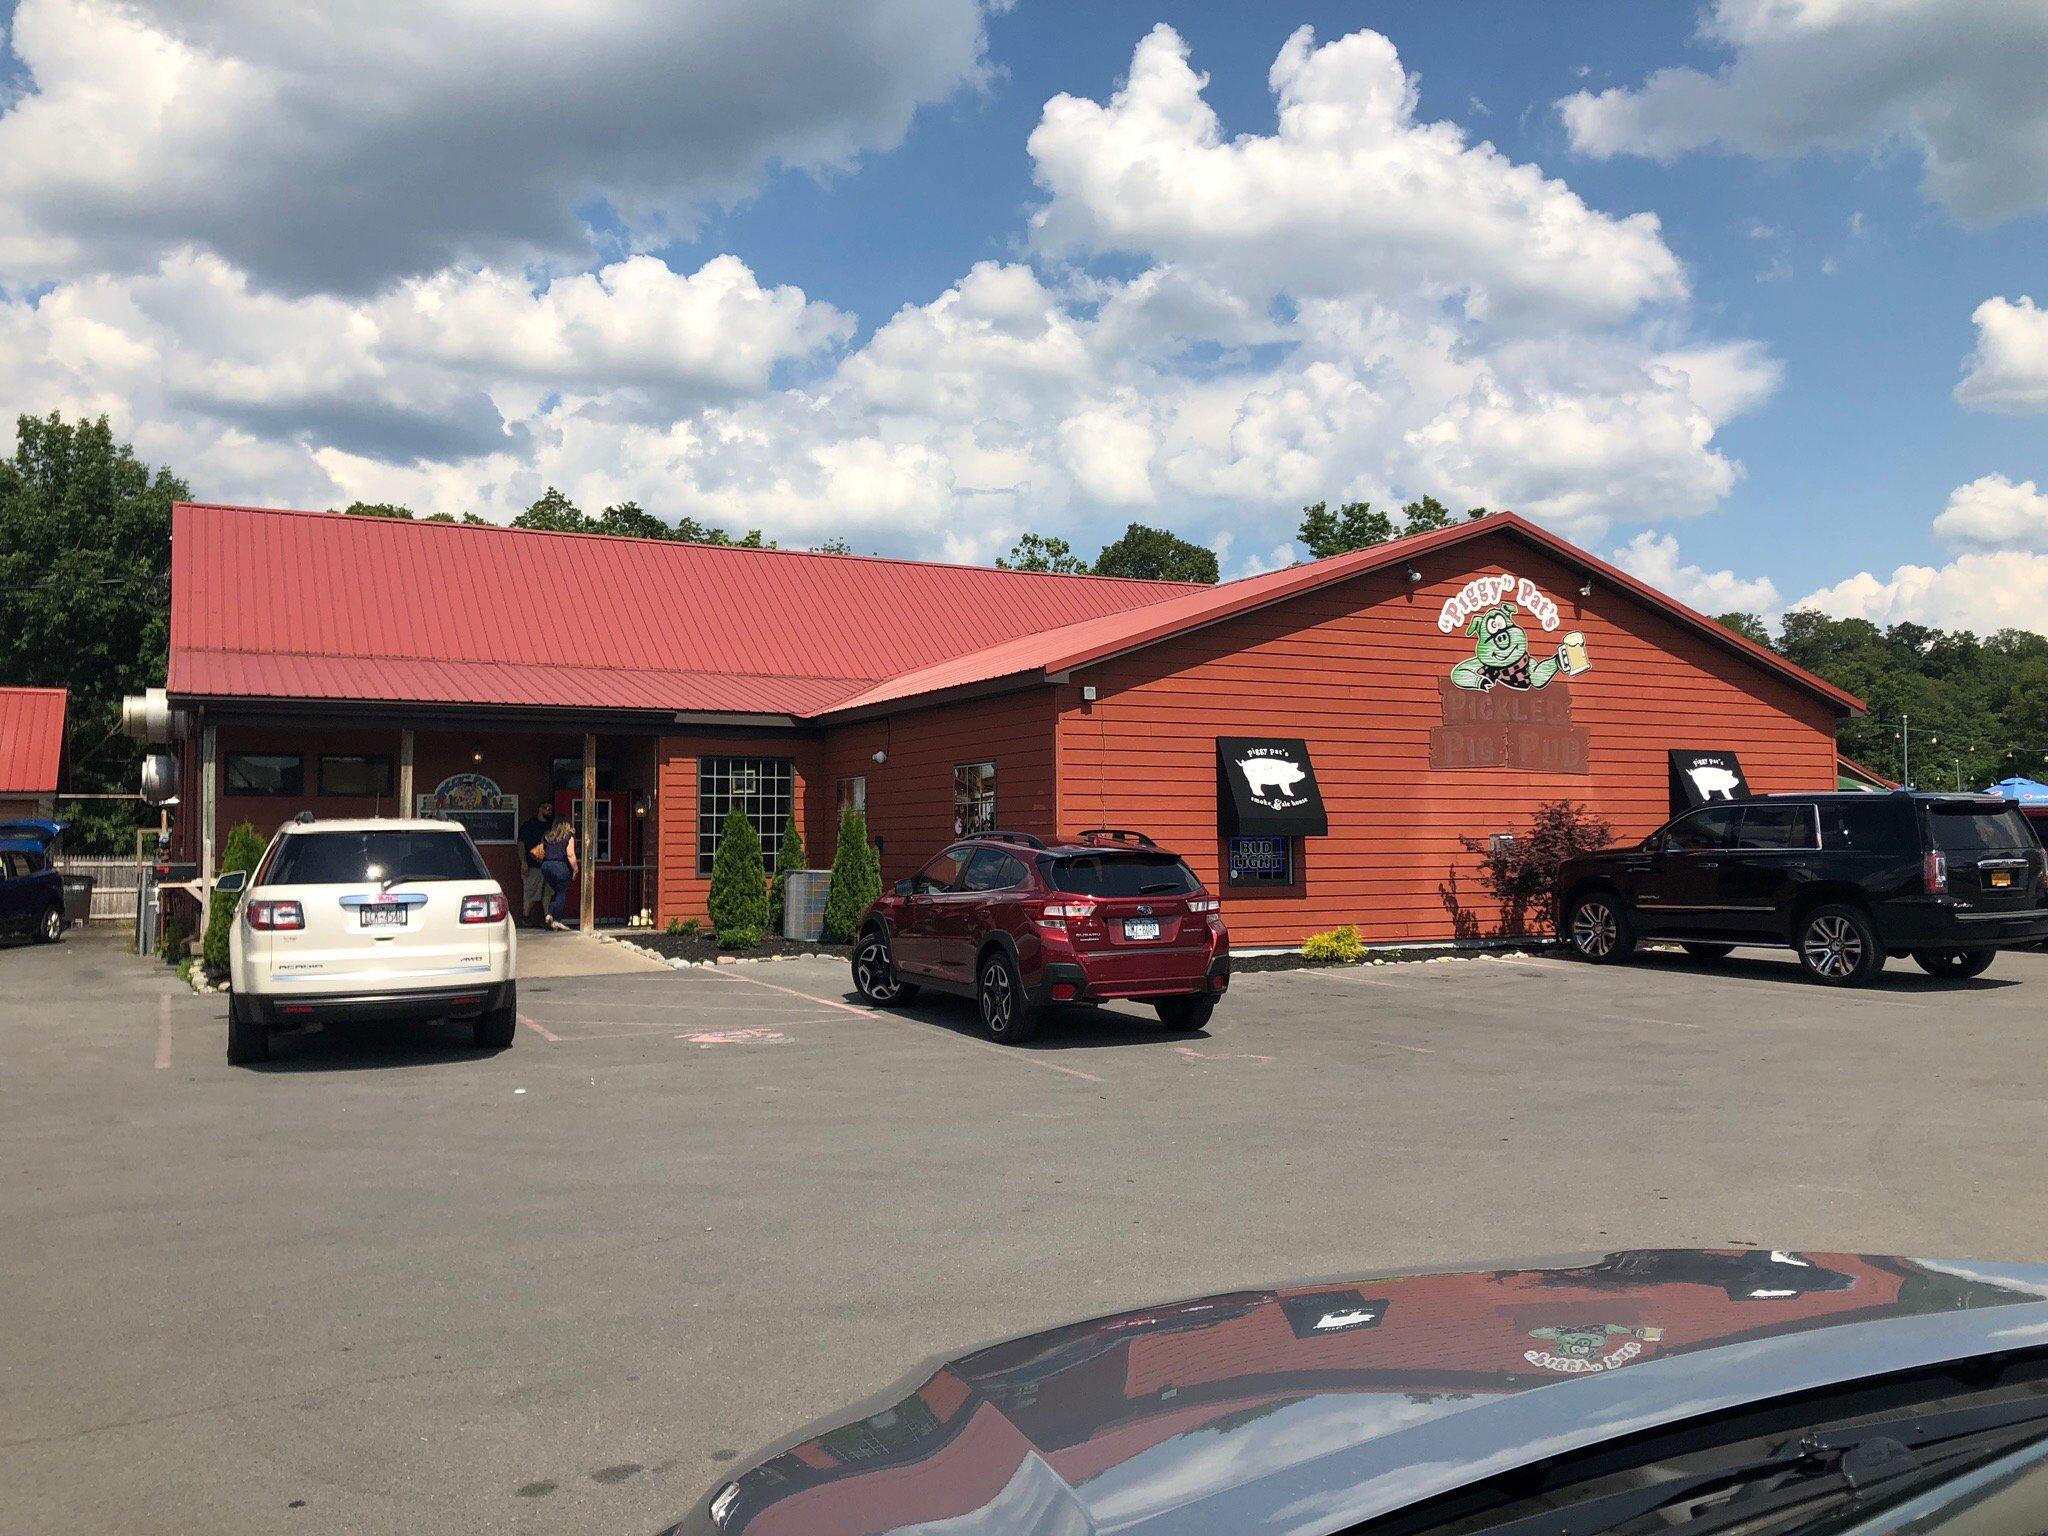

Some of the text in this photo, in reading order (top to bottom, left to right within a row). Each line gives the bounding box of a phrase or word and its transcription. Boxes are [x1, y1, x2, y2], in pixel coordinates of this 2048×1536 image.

[1519, 579, 1559, 631] Pat's
[1239, 841, 1273, 854] BUD
[1234, 853, 1280, 870] LIGHT
